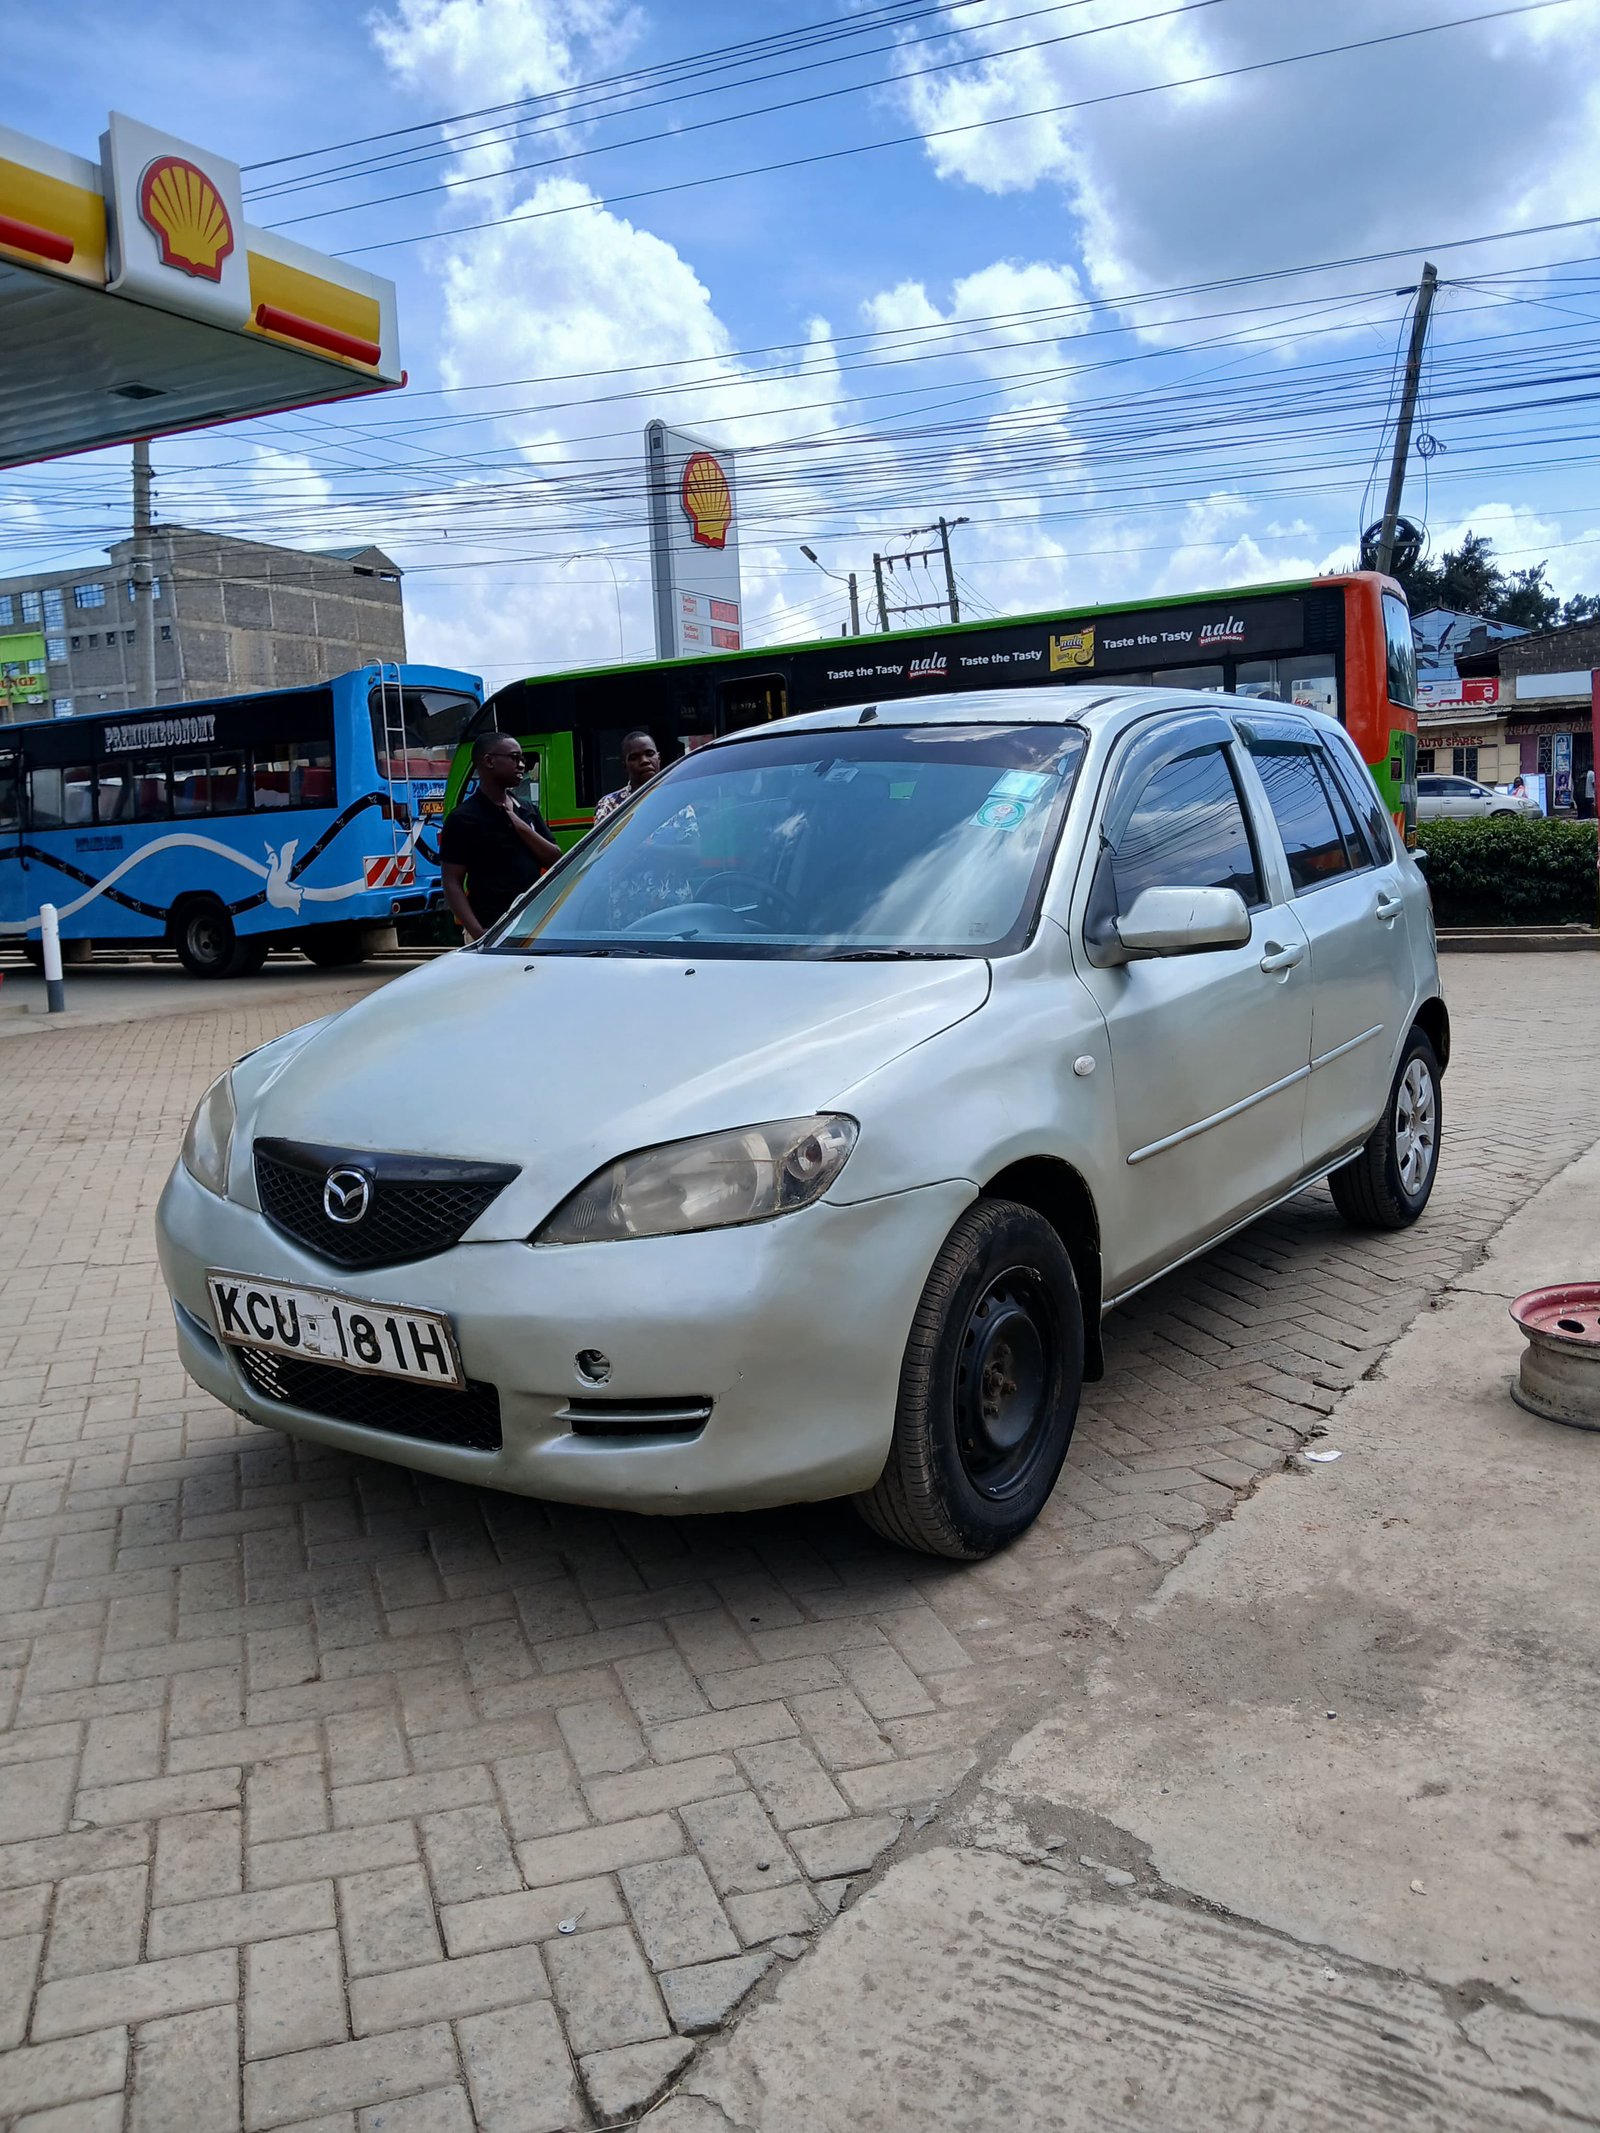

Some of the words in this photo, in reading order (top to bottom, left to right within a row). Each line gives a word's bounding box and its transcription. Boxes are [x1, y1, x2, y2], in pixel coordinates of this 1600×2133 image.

[1200, 616, 1245, 637] nala
[1103, 640, 1134, 649] Taste
[1137, 634, 1158, 645] the
[1160, 631, 1193, 642] Tasty
[910, 651, 948, 671] nala
[960, 657, 989, 666] Taste
[991, 653, 1010, 663] the
[1012, 650, 1042, 661] Tasty
[827, 671, 854, 680] Taste
[856, 667, 874, 676] the
[875, 664, 903, 675] Tasty
[1508, 723, 1530, 735] NEW
[1418, 737, 1443, 748] AUTO
[1446, 736, 1484, 746] SPARES
[215, 1283, 301, 1347] KCU
[331, 1305, 449, 1375] 181H
